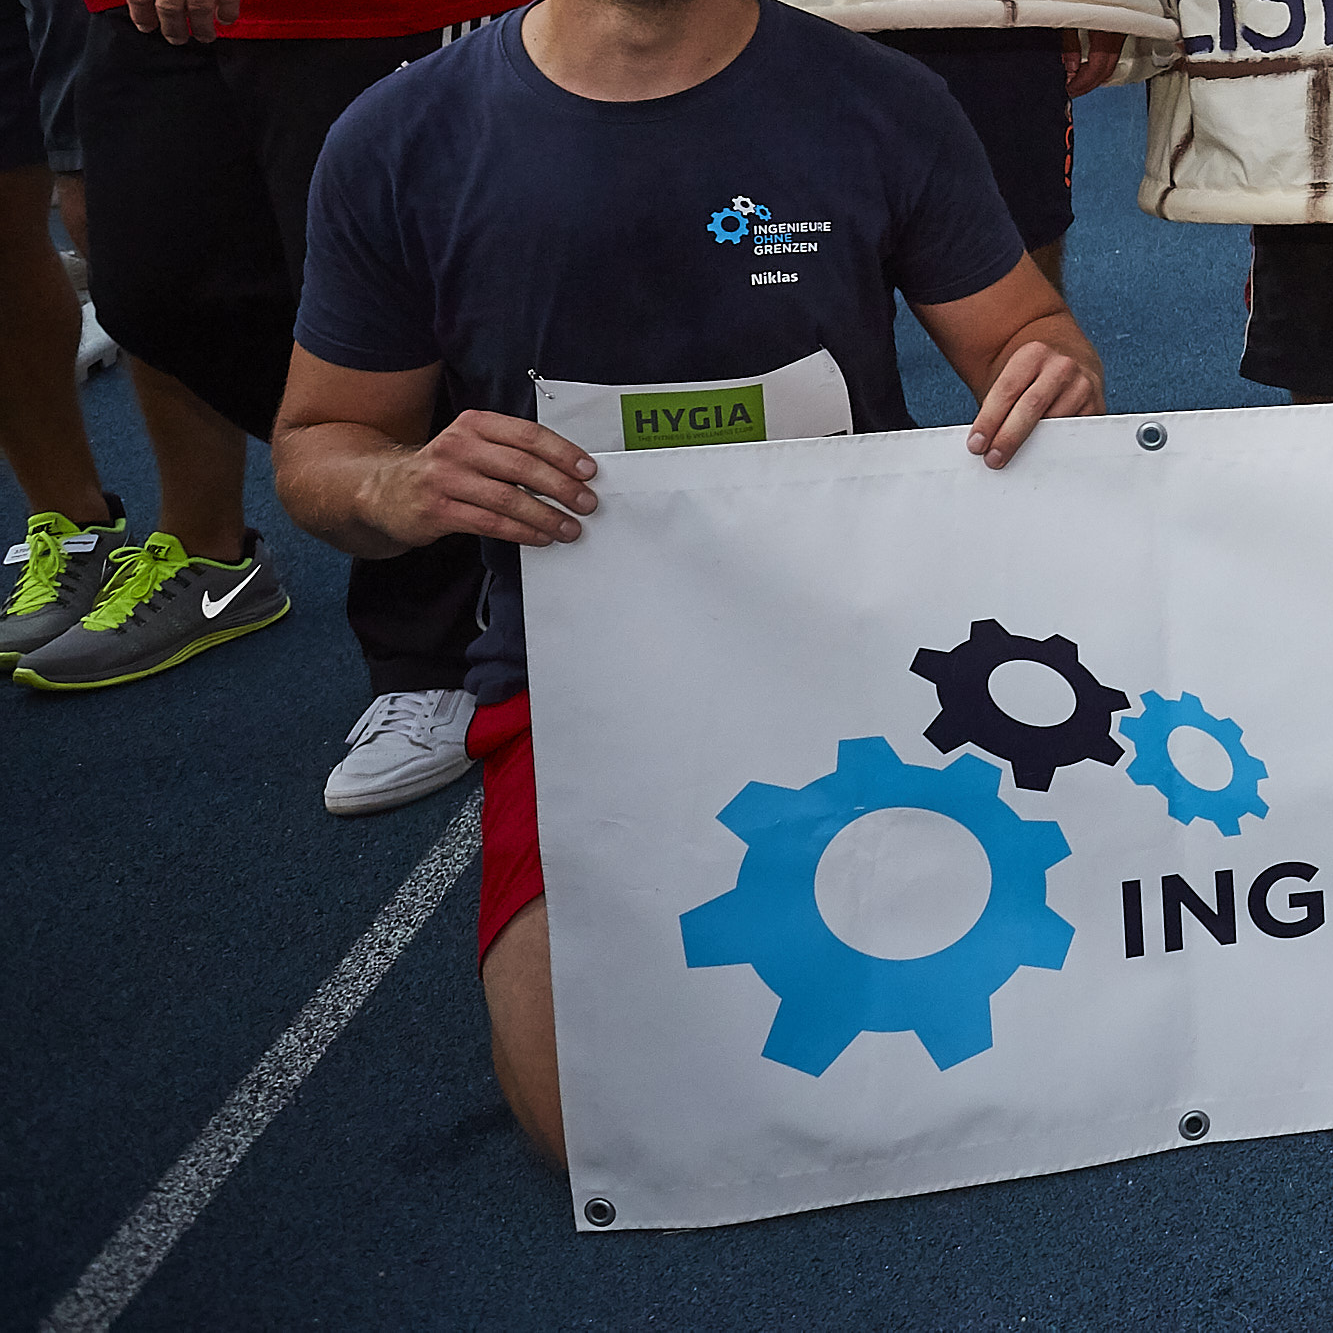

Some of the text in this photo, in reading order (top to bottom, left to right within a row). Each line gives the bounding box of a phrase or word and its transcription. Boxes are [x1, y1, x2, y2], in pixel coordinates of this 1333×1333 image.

[753, 221, 832, 235] INGENIEURE
[753, 233, 793, 245] OHNE
[753, 242, 818, 256] GRENZEN
[751, 270, 799, 286] Niklas
[635, 402, 752, 433] HYGIA
